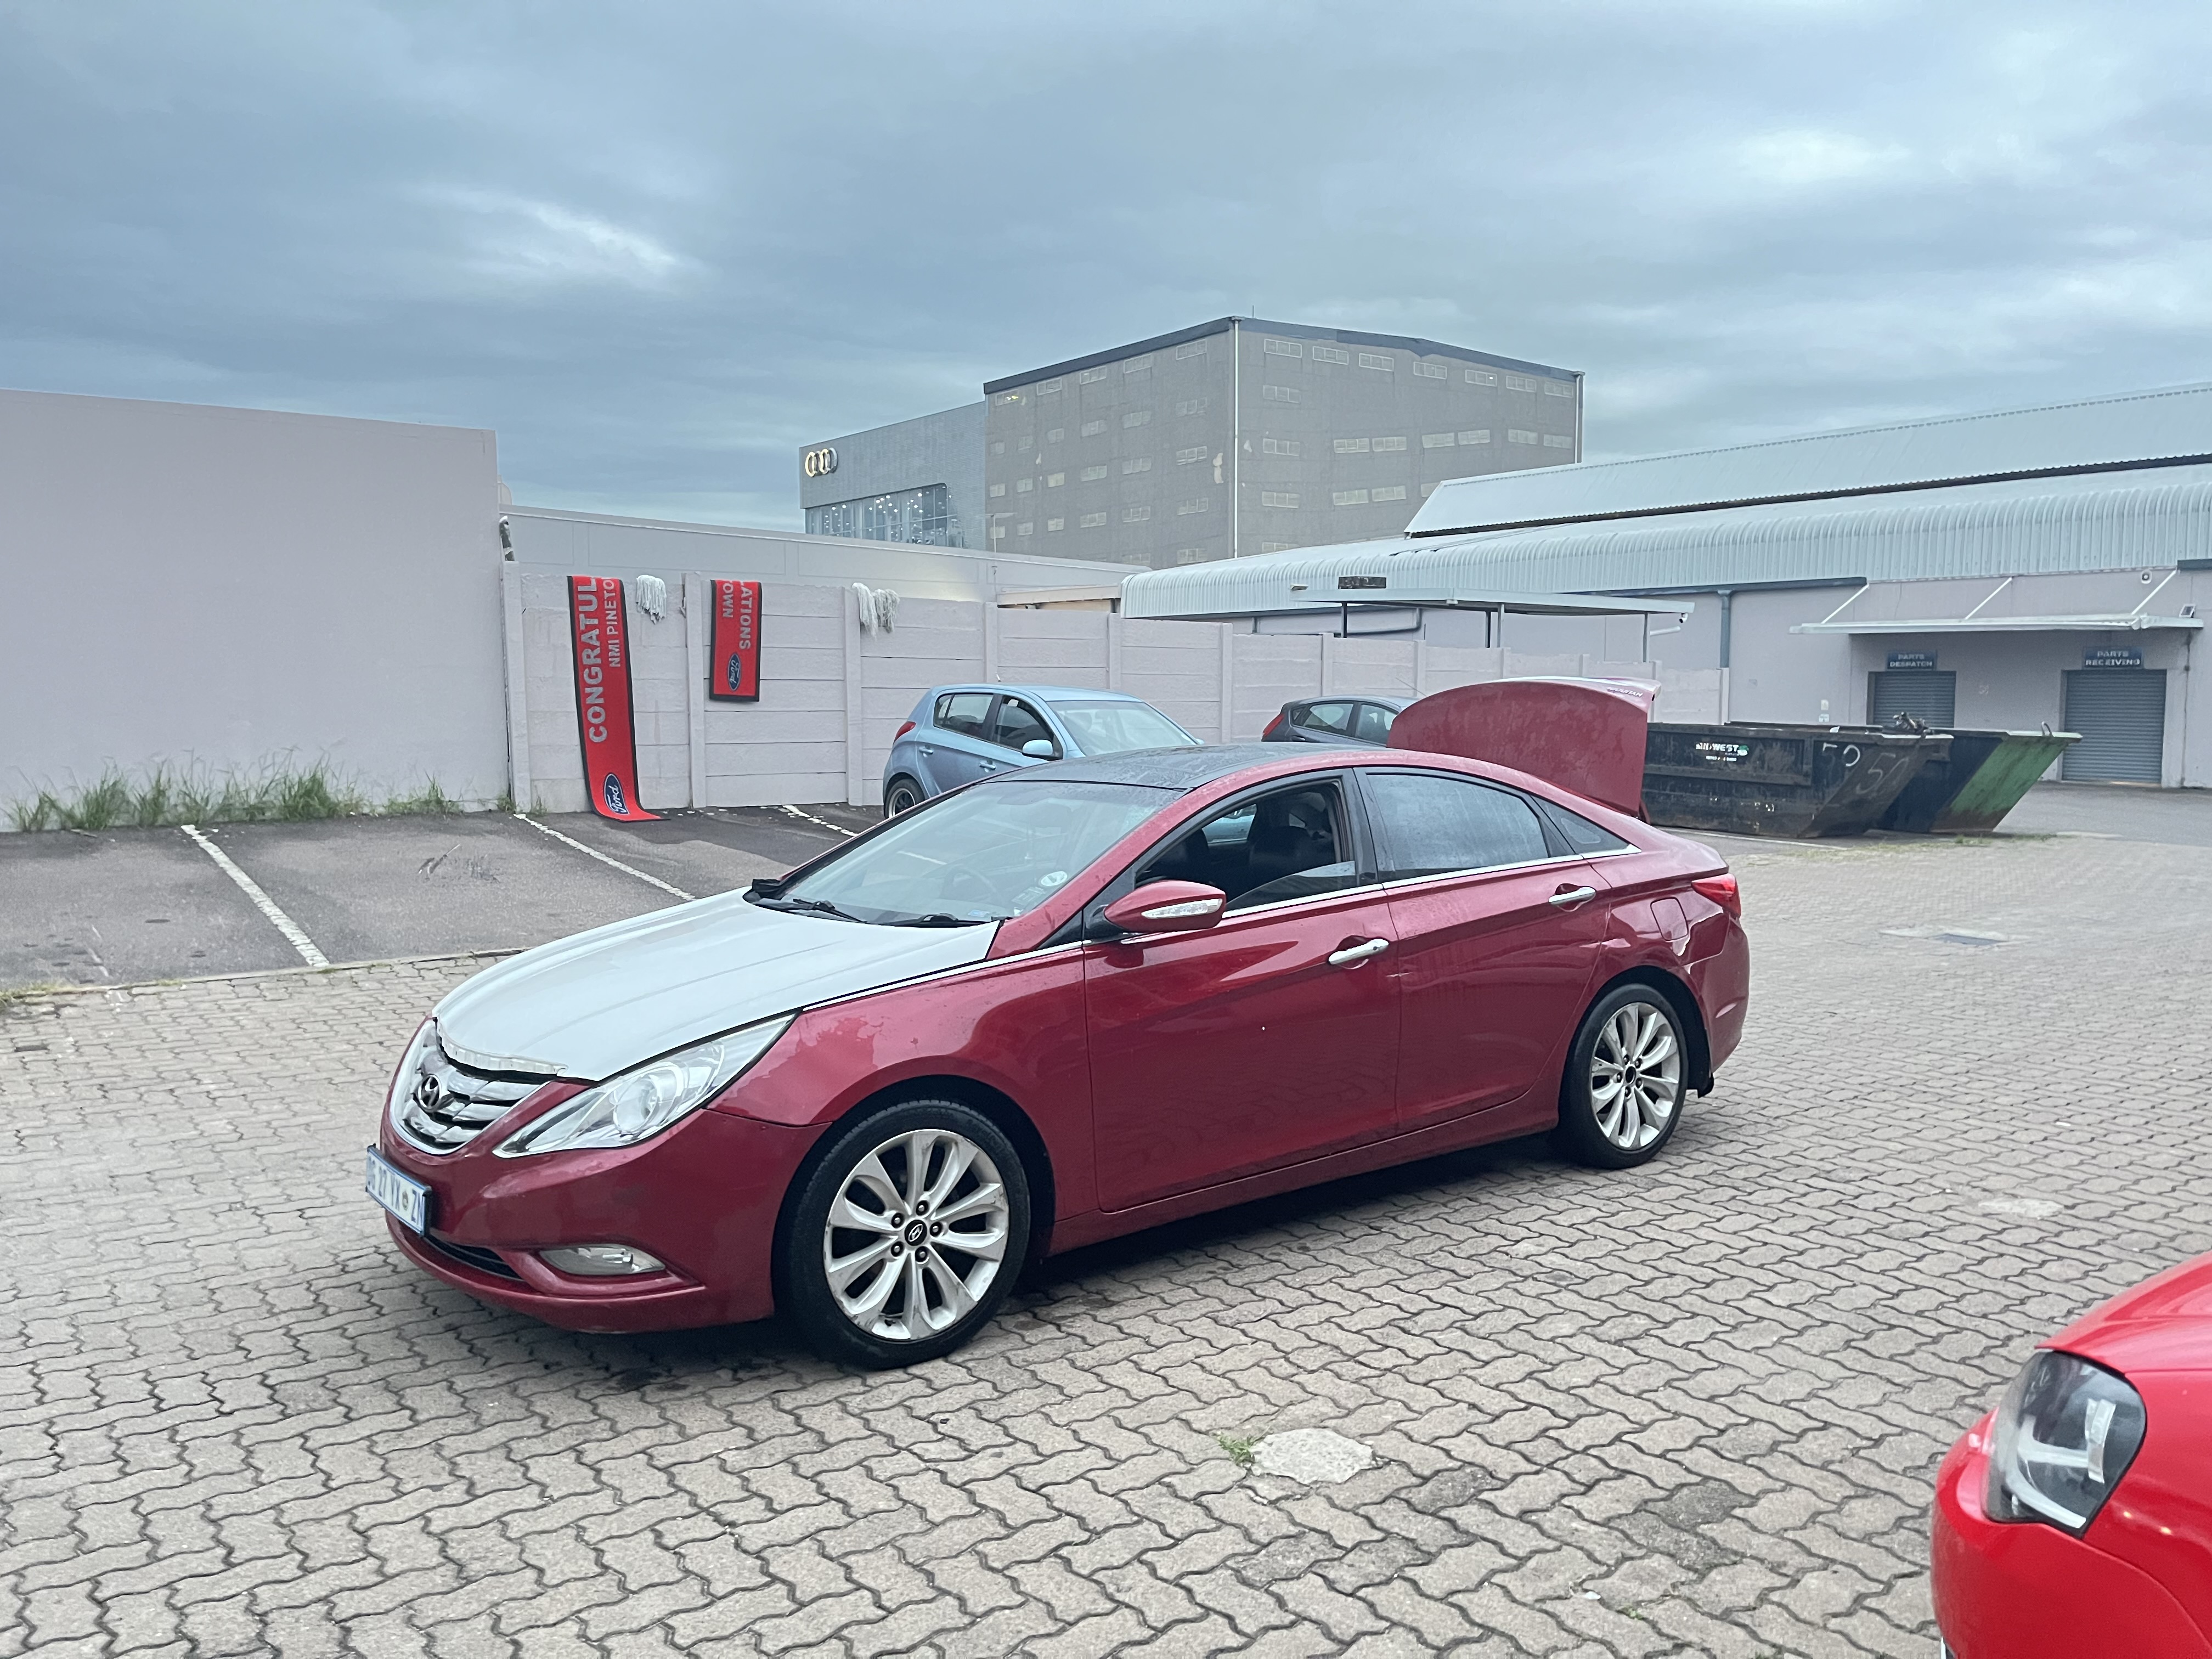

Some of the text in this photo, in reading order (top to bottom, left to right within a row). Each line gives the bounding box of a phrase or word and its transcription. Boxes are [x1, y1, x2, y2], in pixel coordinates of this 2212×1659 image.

[723, 580, 733, 618] OWN
[739, 582, 753, 650] ATIONS
[603, 578, 621, 667] NMI PINETO
[730, 660, 740, 684] Ford
[607, 785, 627, 813] Ford
